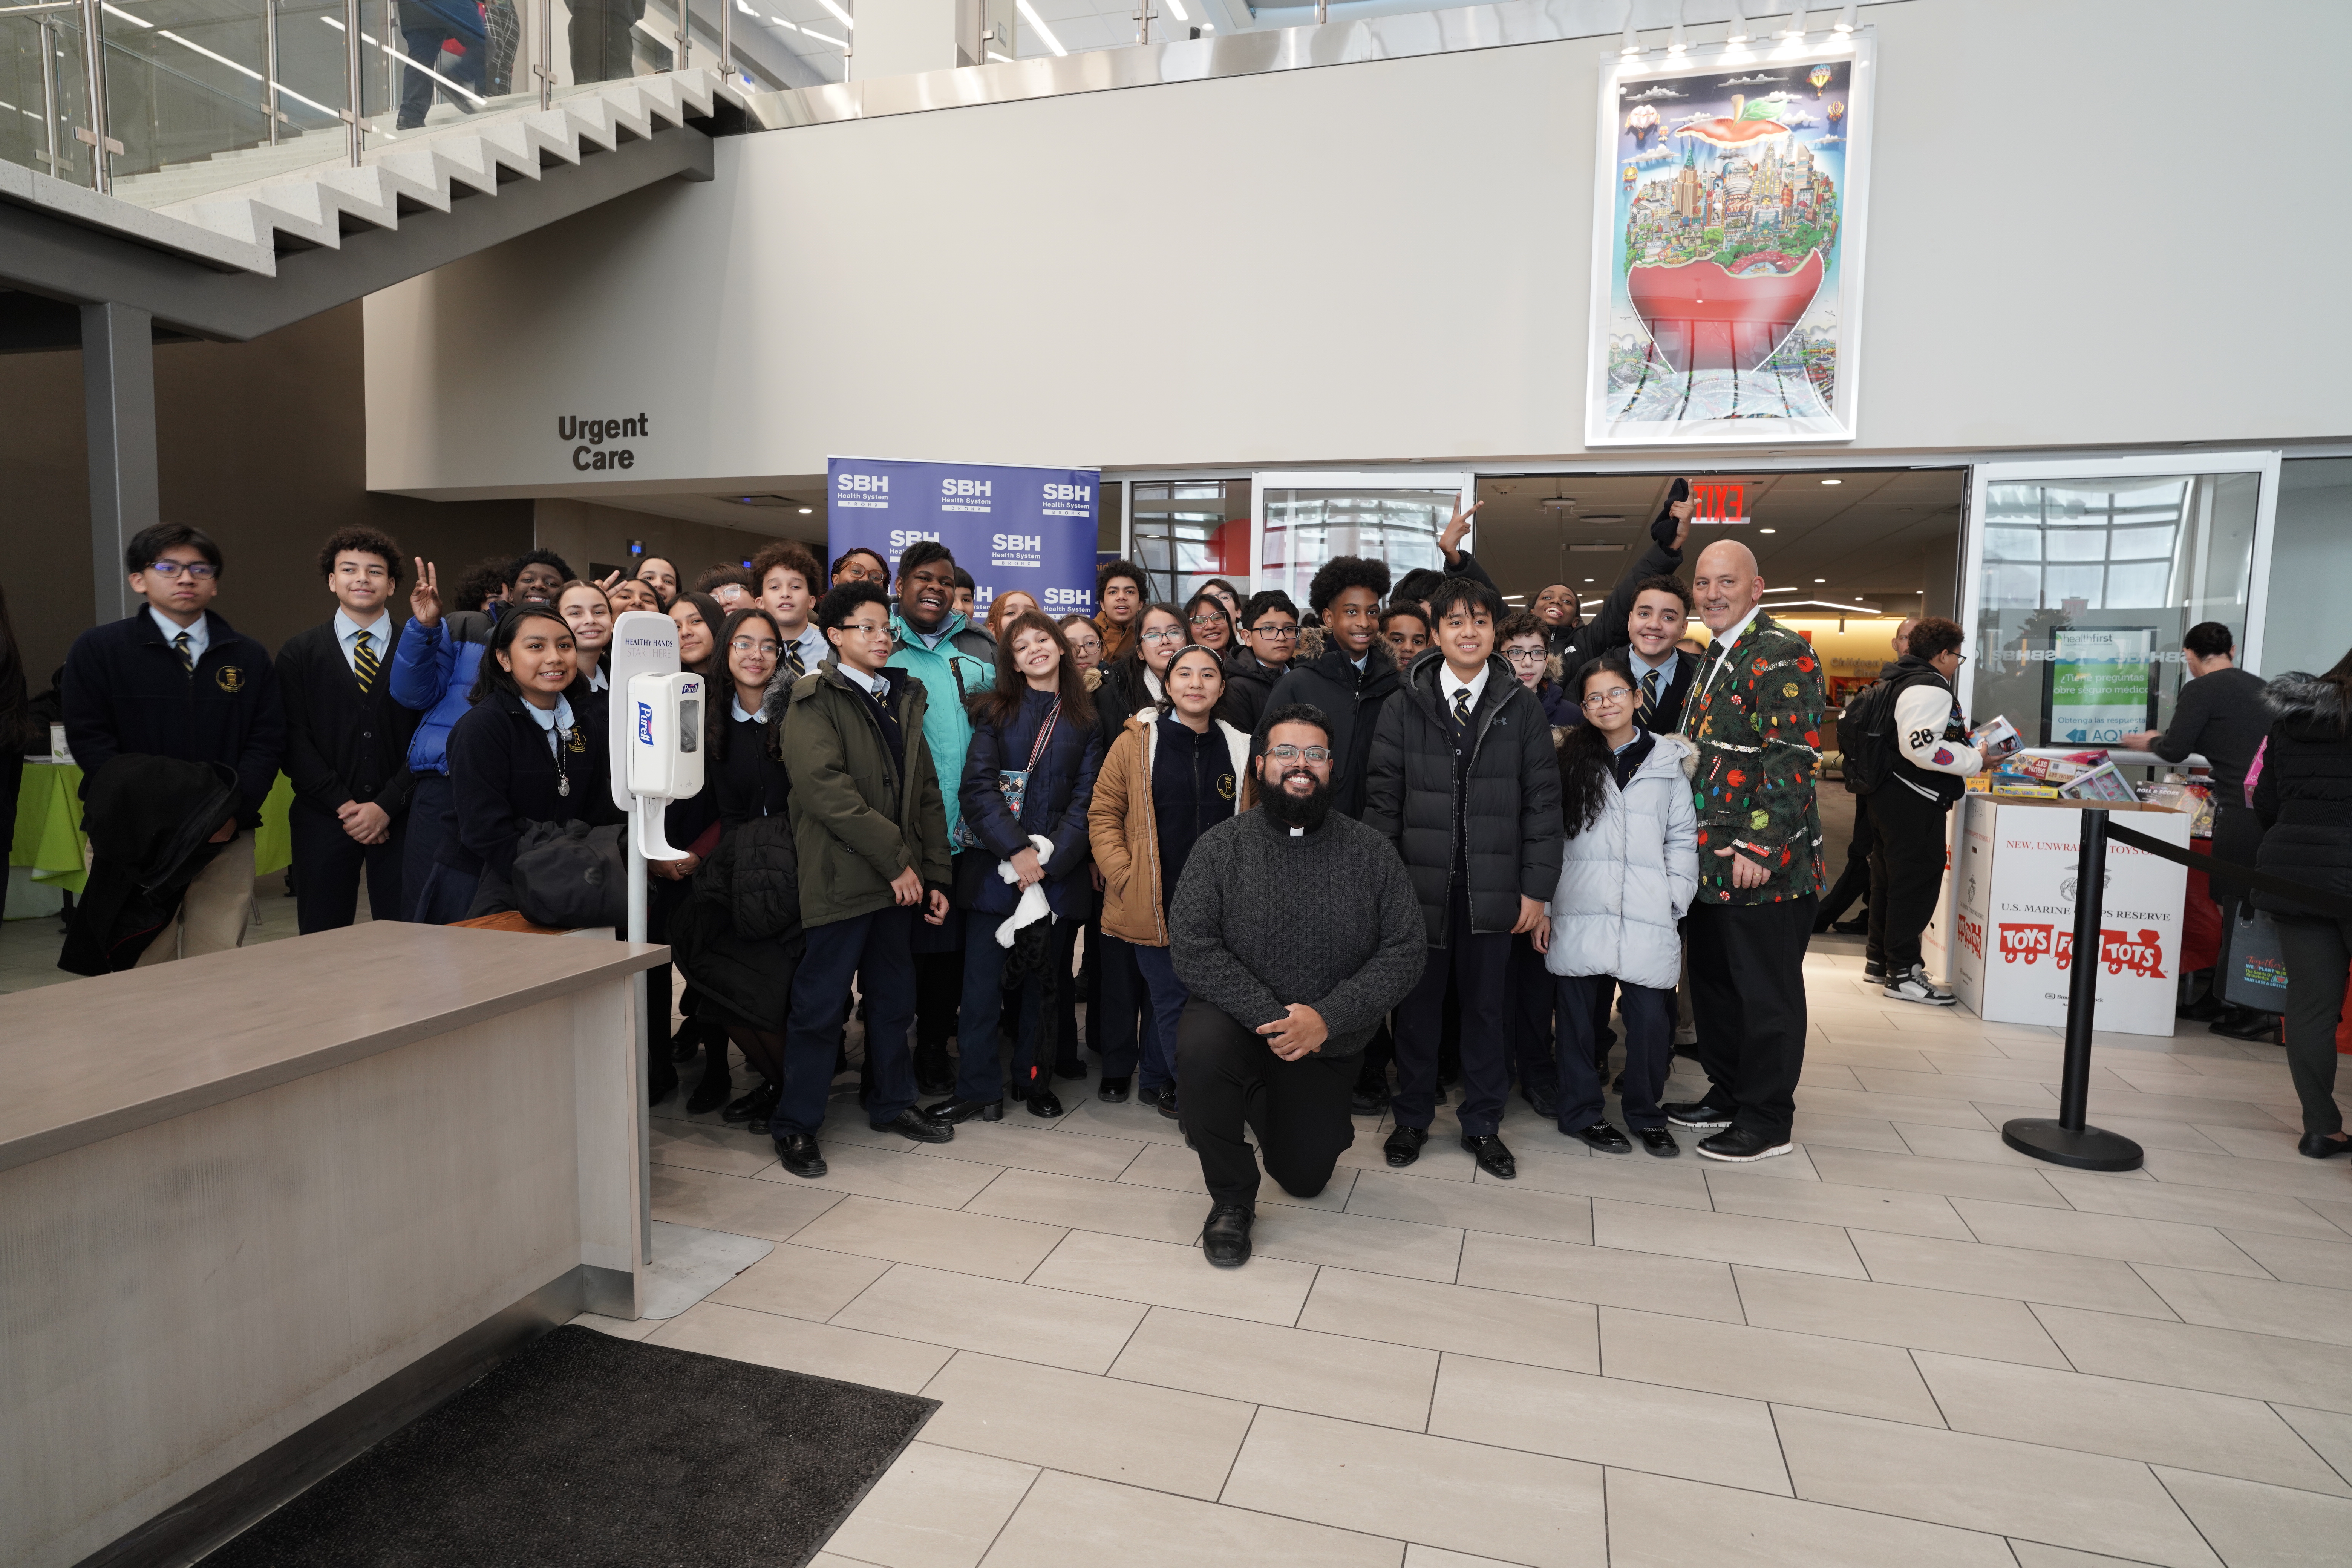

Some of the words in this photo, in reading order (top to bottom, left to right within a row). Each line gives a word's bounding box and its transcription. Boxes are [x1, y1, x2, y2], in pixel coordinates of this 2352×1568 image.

[559, 413, 648, 445] Urgent
[573, 446, 634, 471] Care
[838, 474, 888, 492] SBH
[942, 478, 991, 496] SBH
[1043, 483, 1090, 501] SBH
[890, 530, 940, 547] SBH
[992, 534, 1041, 551] SBH
[1044, 588, 1091, 605] SBH
[2064, 634, 2112, 643] healthfirst
[627, 648, 650, 657] START
[653, 649, 671, 658] HERE
[2061, 674, 2092, 683] ¿Tiene
[2095, 674, 2144, 683] preguntas
[641, 707, 651, 742] Purell
[2028, 765, 2046, 775] DRUM
[2006, 841, 2034, 850] NEW,
[2037, 842, 2080, 851] UNWRA
[2110, 845, 2138, 855] TOYS
[2001, 903, 2021, 911] U.S.
[2024, 905, 2071, 915] MARINE
[2116, 911, 2171, 921] RESERVE
[2003, 928, 2047, 950] TOYS
[2106, 943, 2154, 967] TOTS
[2246, 972, 2269, 981] Knowledge
